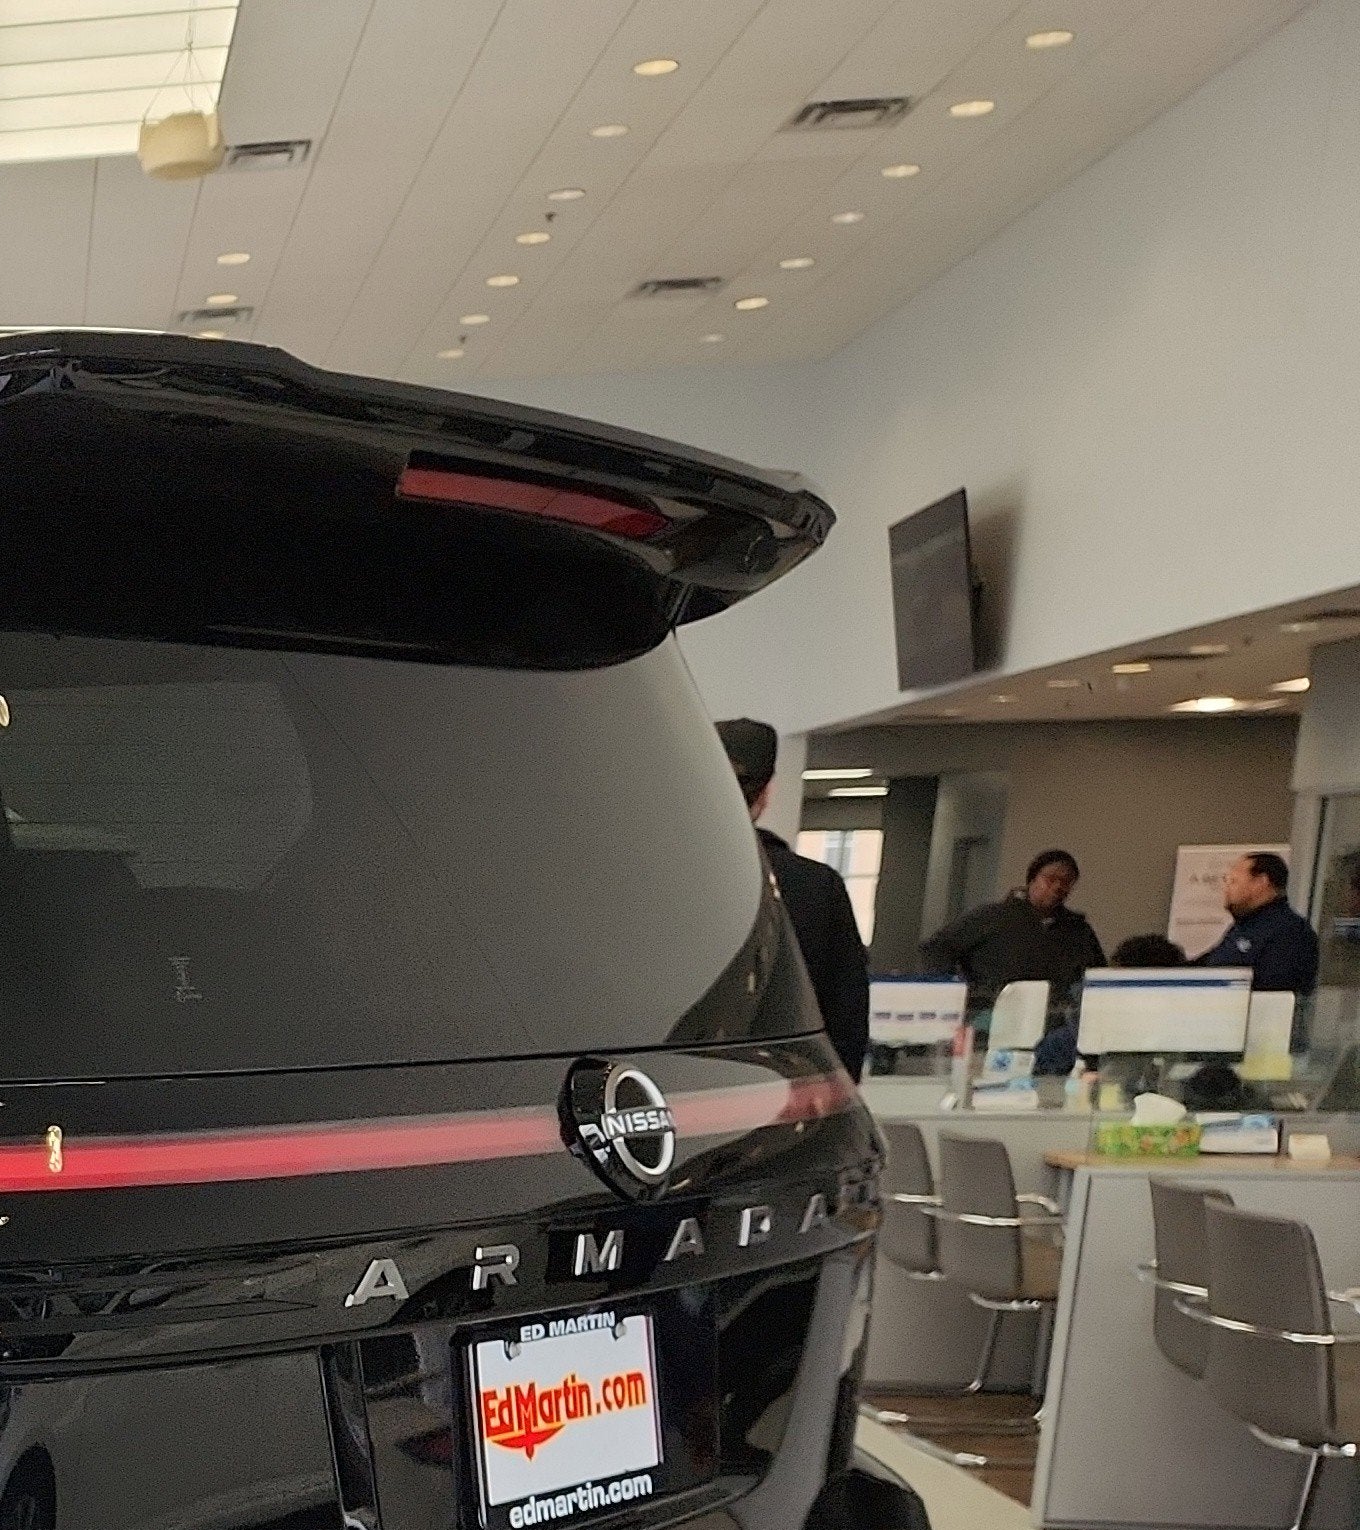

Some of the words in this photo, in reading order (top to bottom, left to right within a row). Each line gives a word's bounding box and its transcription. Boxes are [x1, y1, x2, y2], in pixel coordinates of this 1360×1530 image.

[344, 1194, 832, 1308] ARMADA
[520, 1325, 546, 1342] ED
[549, 1311, 616, 1337] MARTIN
[482, 1371, 647, 1440] EdMartin.com
[509, 1473, 653, 1529] edmartin.com
